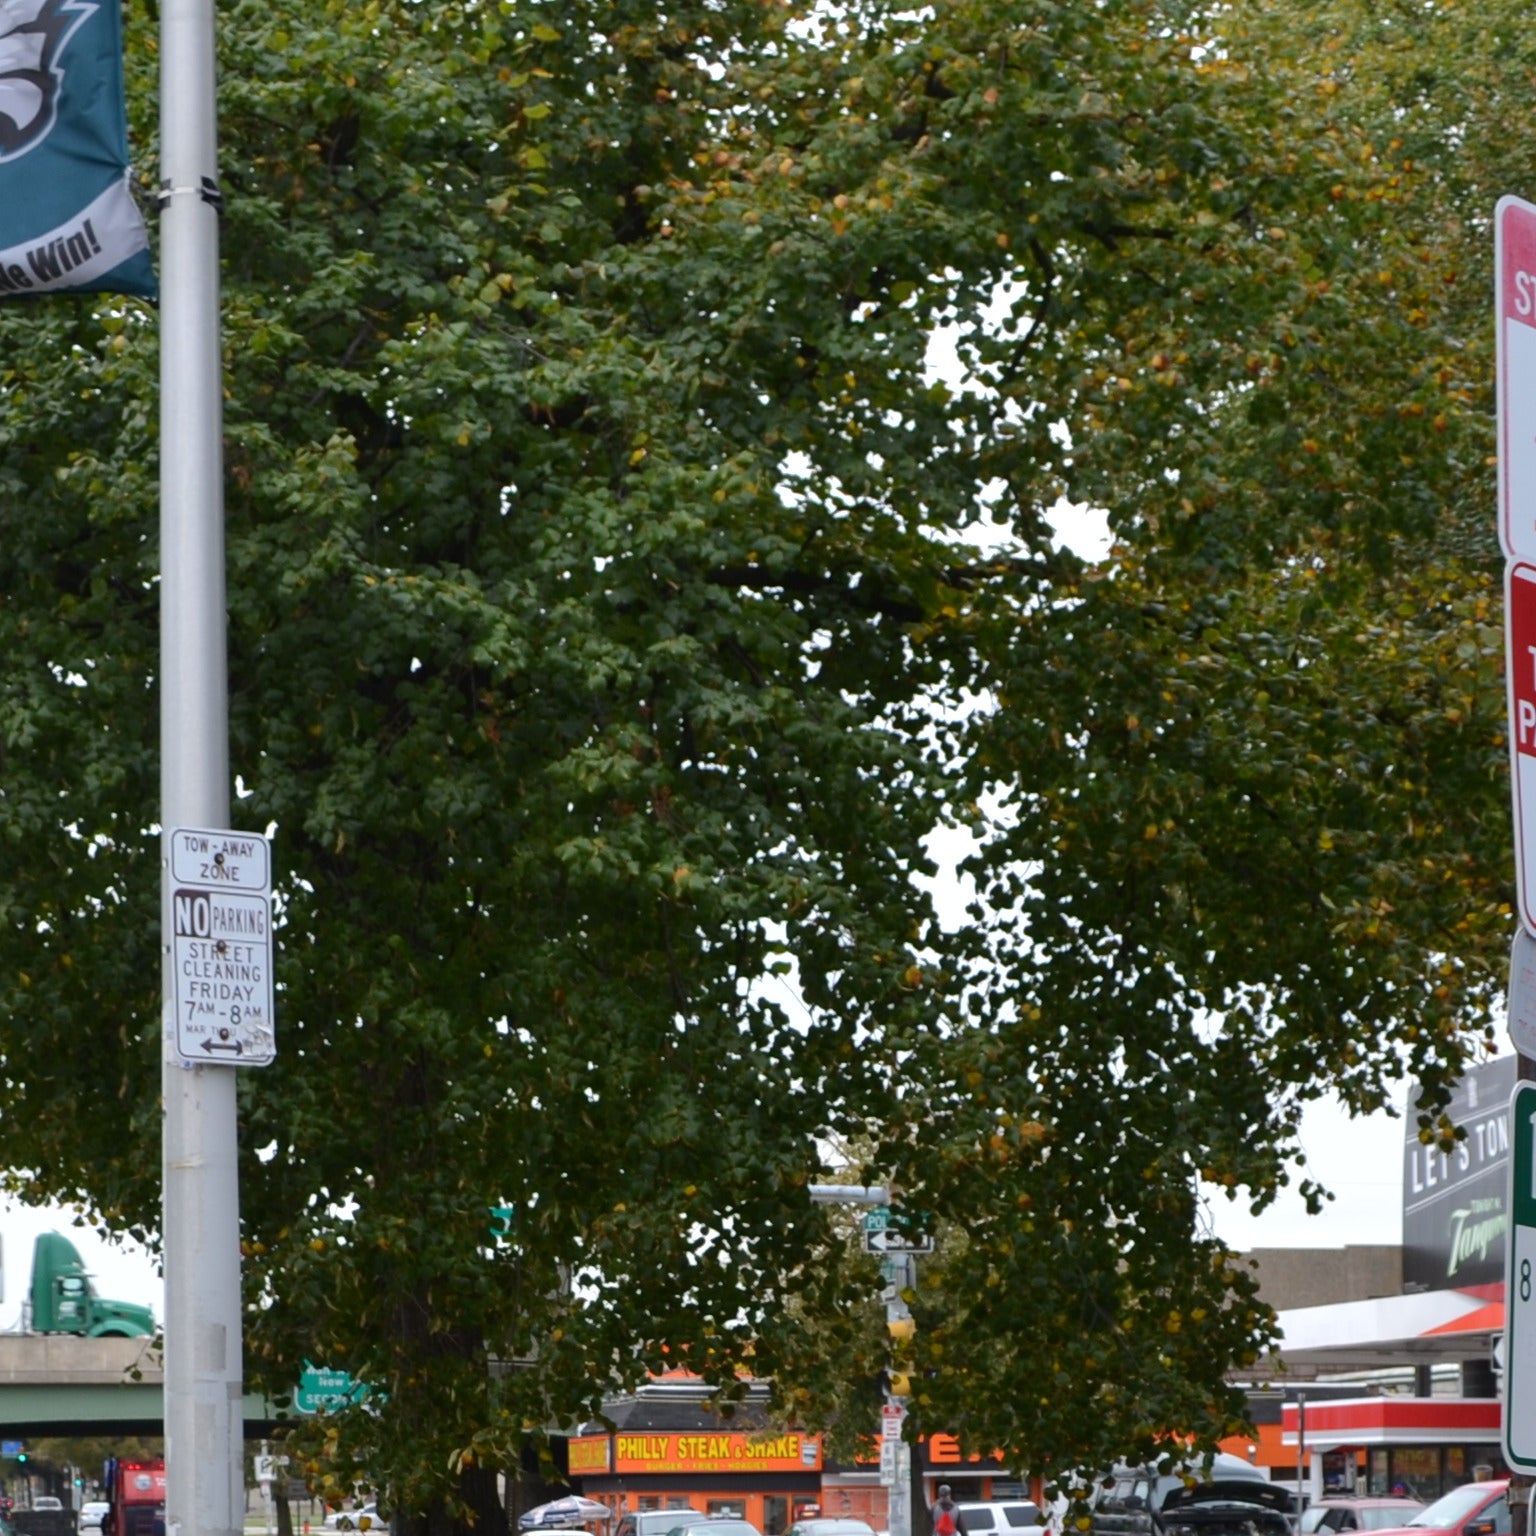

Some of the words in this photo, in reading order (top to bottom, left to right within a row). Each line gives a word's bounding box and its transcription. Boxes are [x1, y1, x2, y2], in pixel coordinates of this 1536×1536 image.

[26, 218, 103, 283] Win!
[200, 863, 240, 882] ZONE
[175, 895, 210, 937] NO
[214, 907, 264, 935] PARKING
[189, 942, 254, 963] STREET
[183, 960, 261, 982] CLEANING
[190, 981, 255, 1001] FRIDAY
[185, 1024, 205, 1034] MAR
[1519, 1258, 1532, 1303] 8
[617, 1437, 669, 1460] PHILLY
[678, 1436, 731, 1459] STEAK
[746, 1436, 799, 1459] SHAKE
